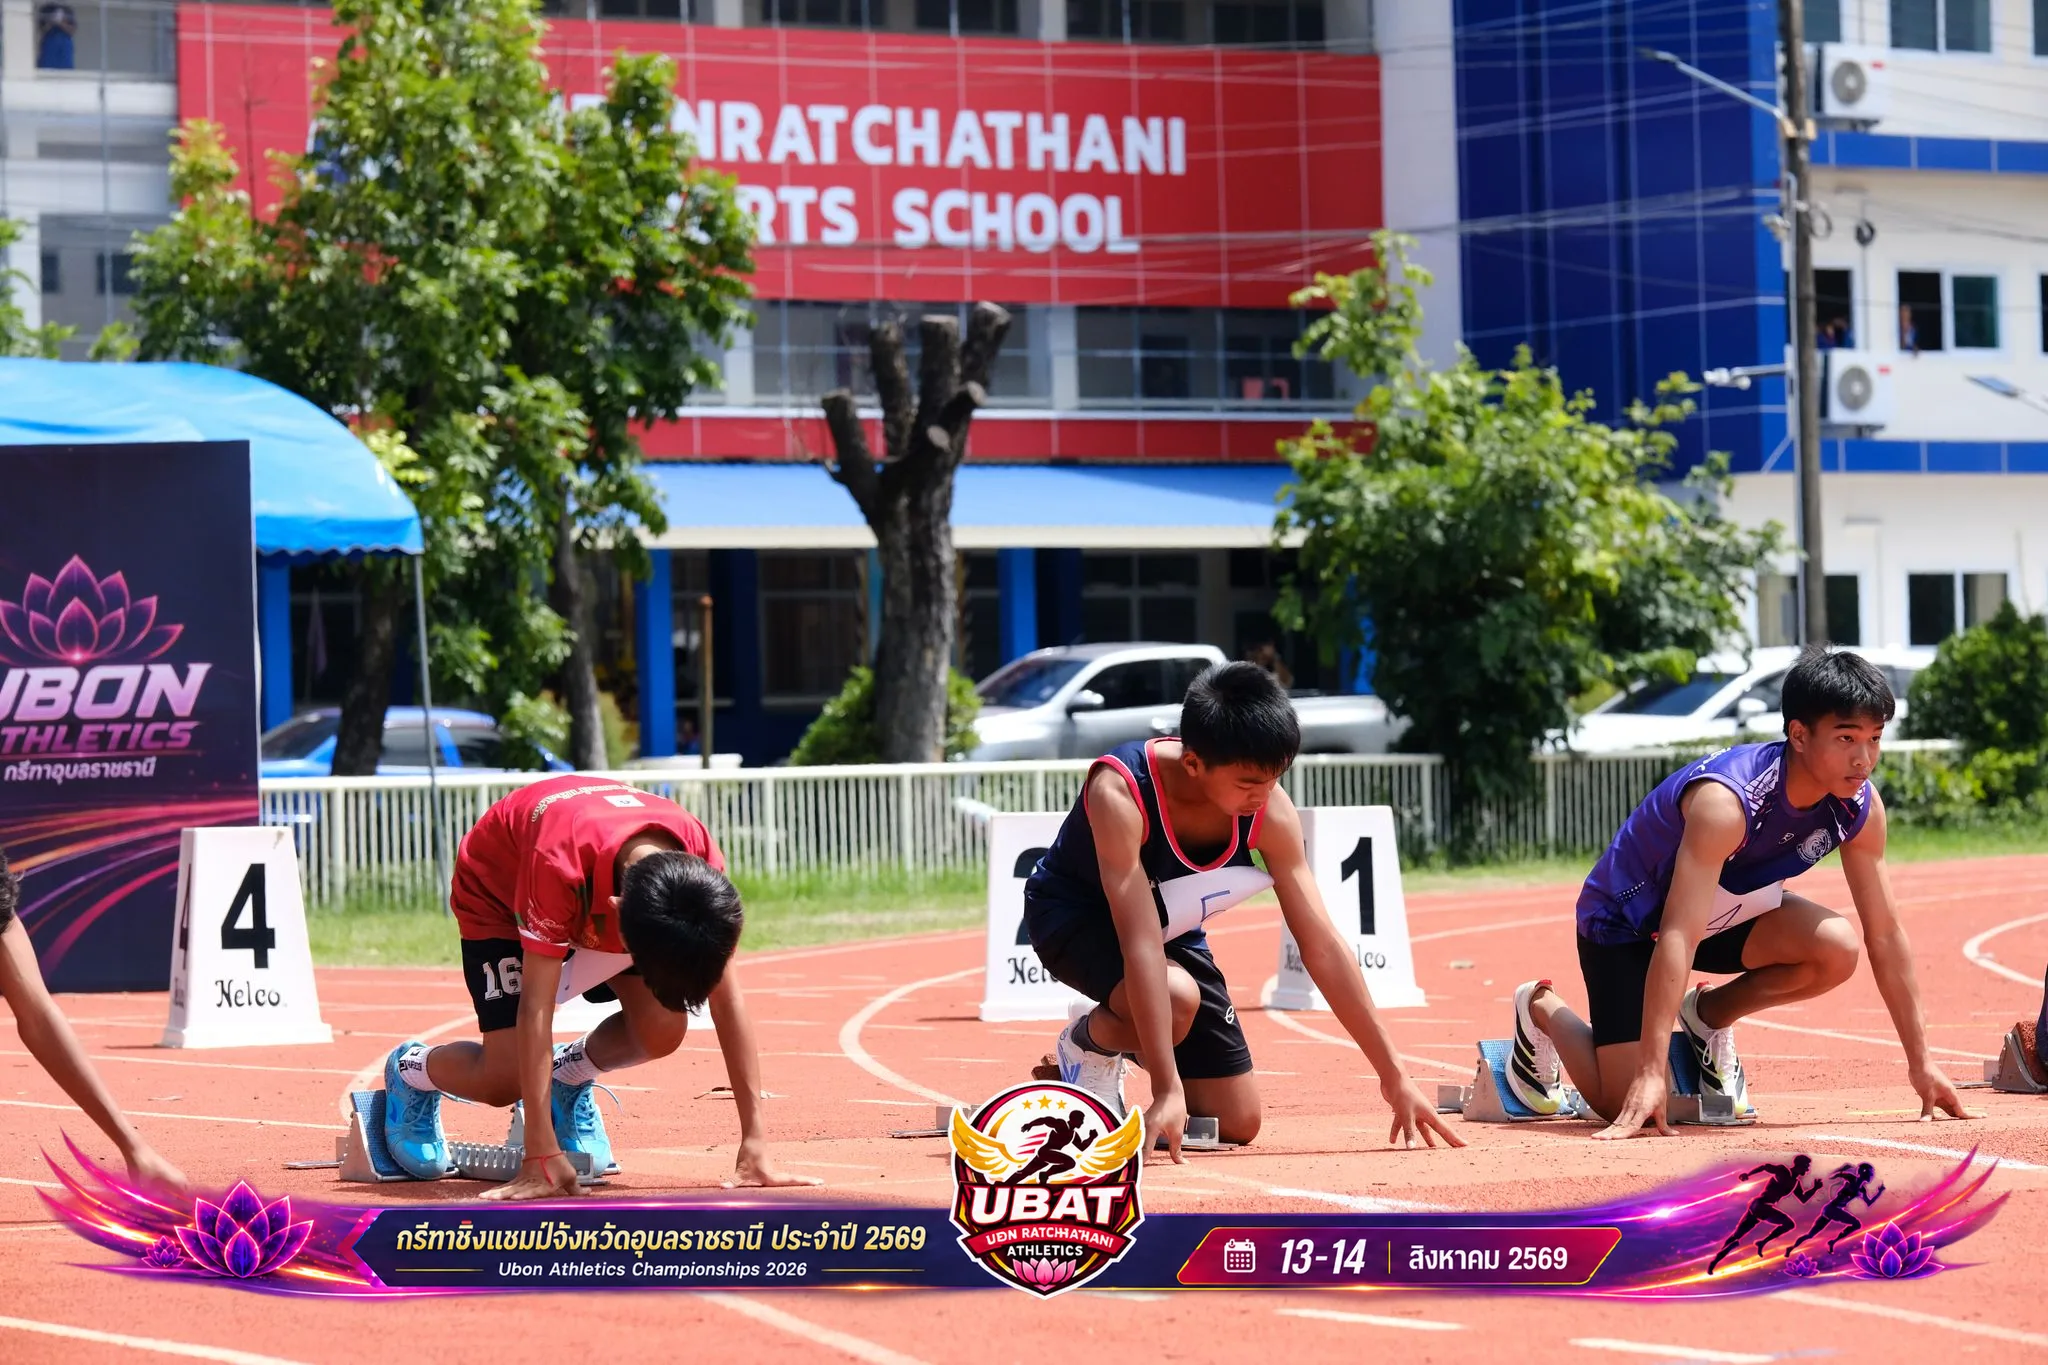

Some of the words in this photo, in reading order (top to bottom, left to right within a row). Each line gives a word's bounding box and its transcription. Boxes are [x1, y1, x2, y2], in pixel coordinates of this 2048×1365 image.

[553, 92, 1187, 176] NRATCHATHANI
[893, 187, 1140, 254] SCHOOL
[0, 721, 200, 754] THLETICS
[1341, 836, 1376, 936] 1
[221, 863, 276, 969] 4
[482, 957, 522, 1001] 16
[1007, 957, 1058, 985] Nel
[1356, 944, 1386, 970] lco
[215, 979, 281, 1008] Nelco
